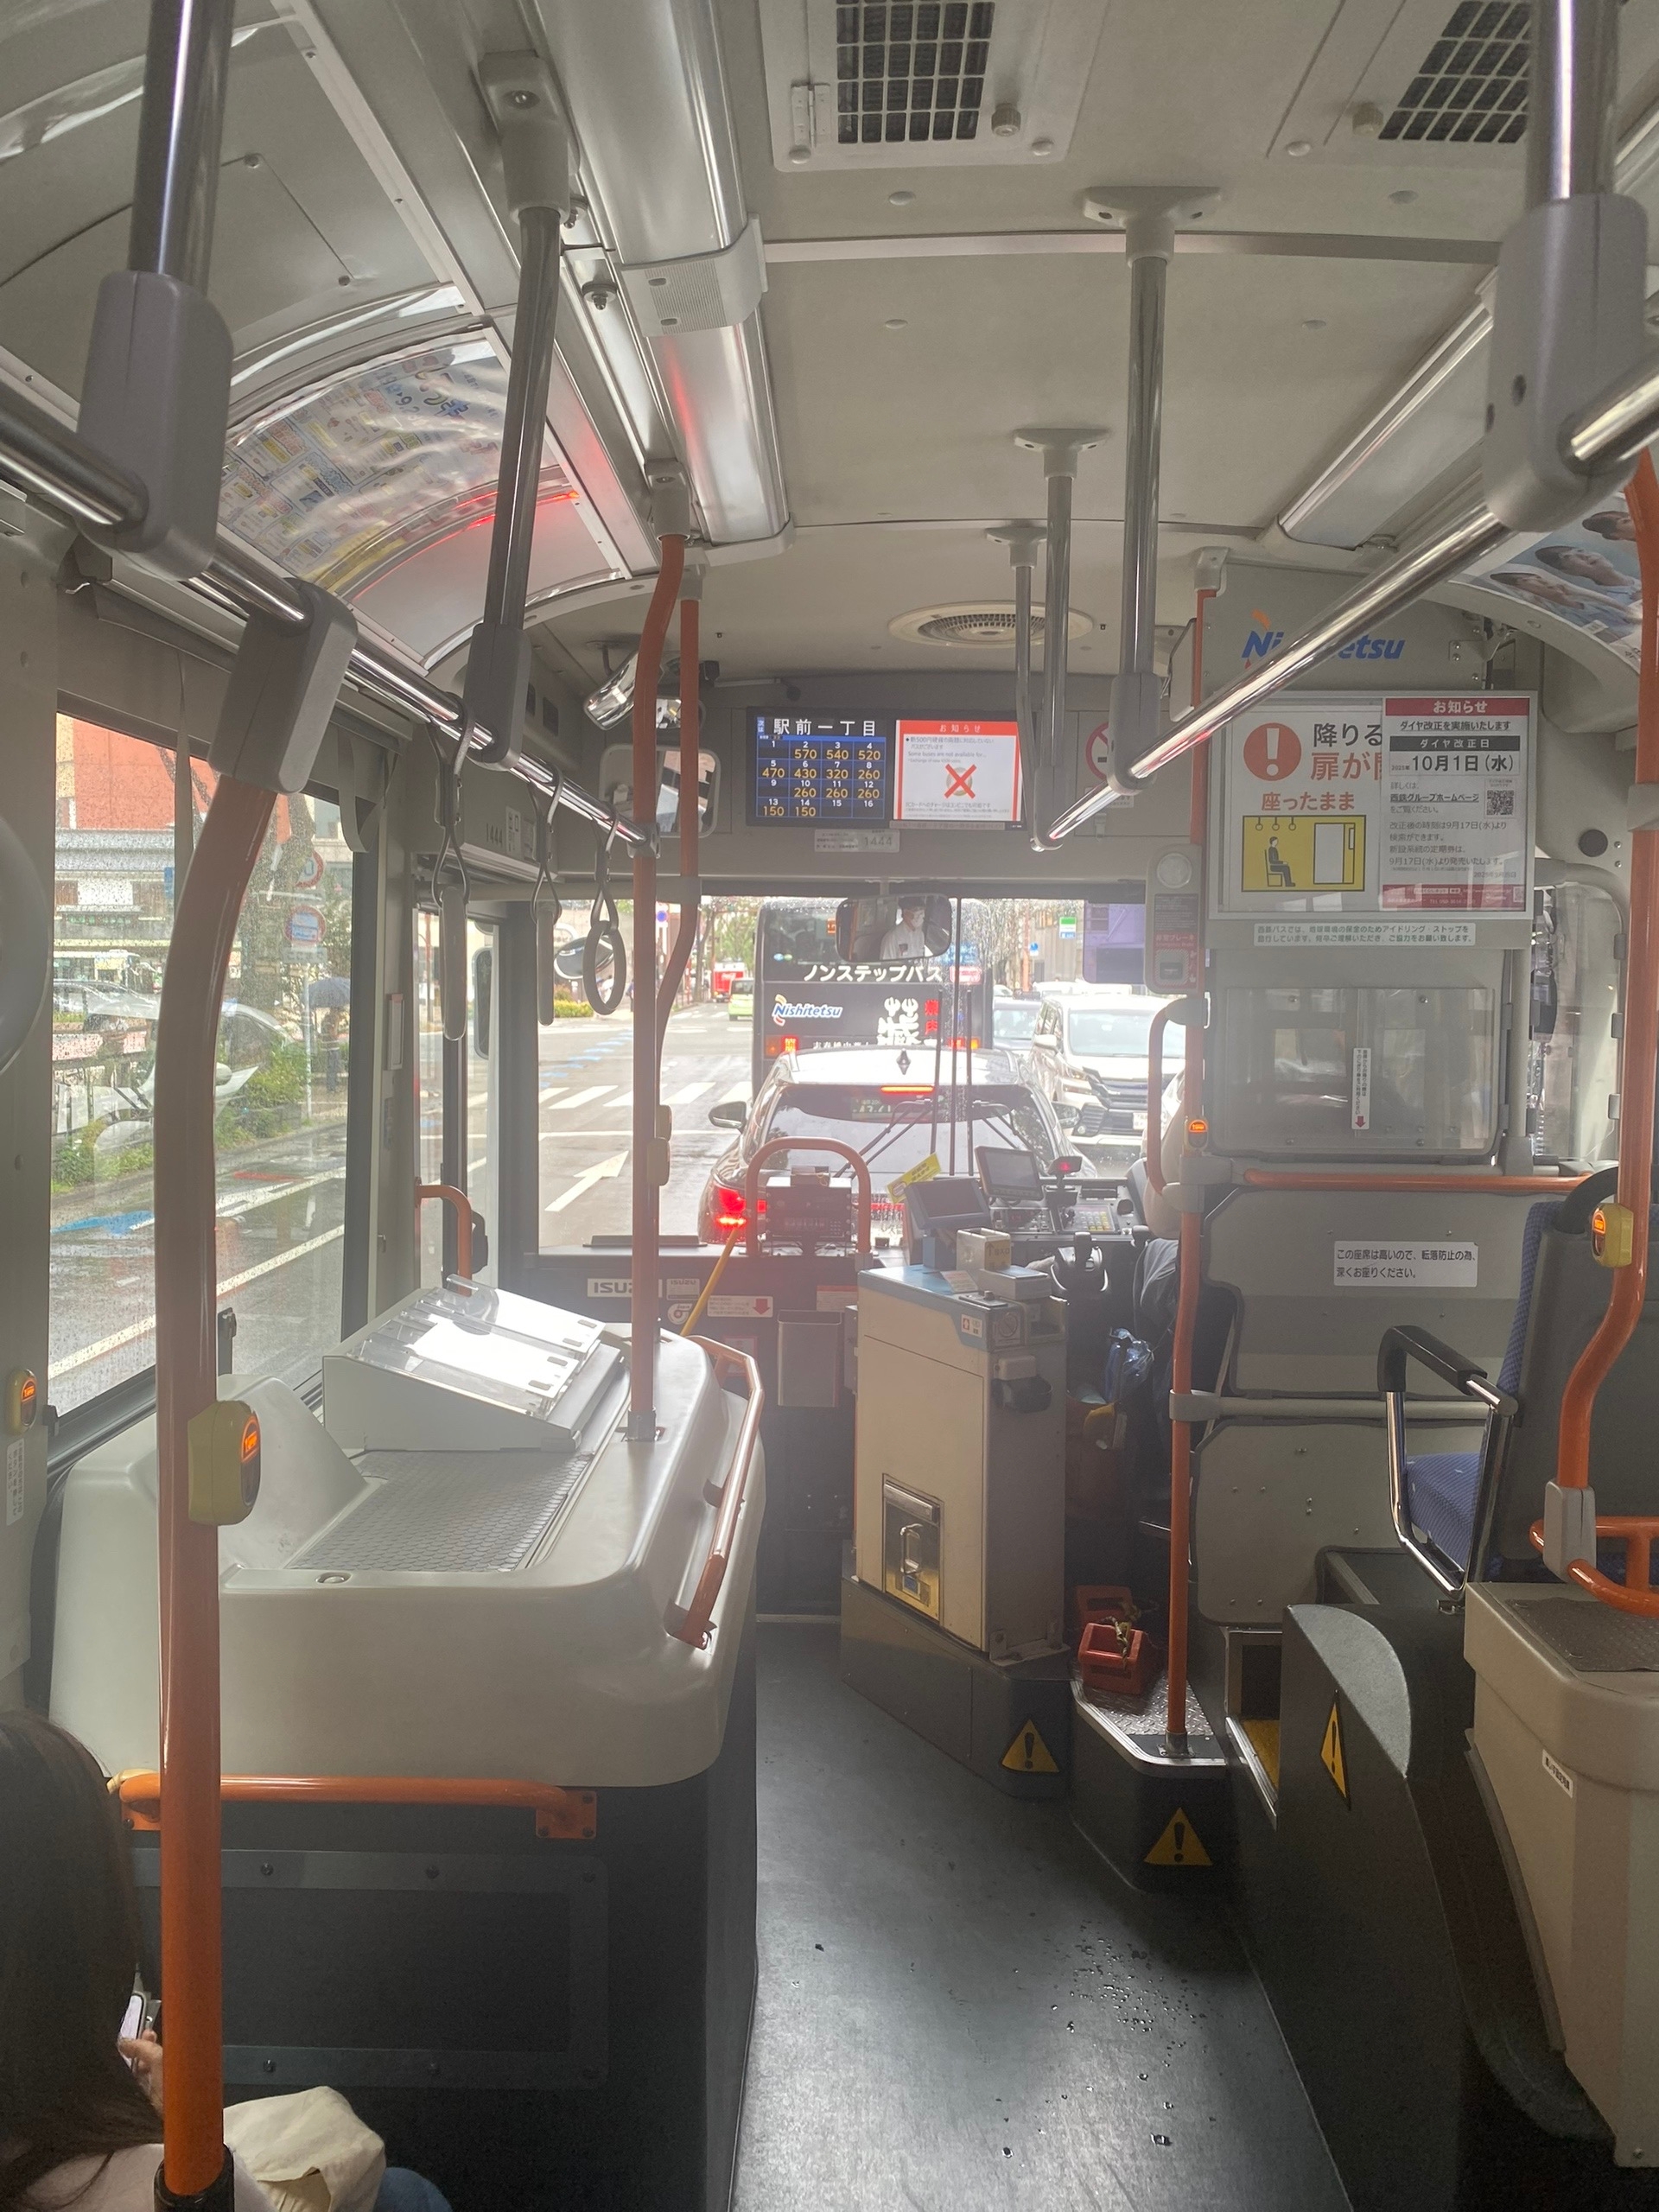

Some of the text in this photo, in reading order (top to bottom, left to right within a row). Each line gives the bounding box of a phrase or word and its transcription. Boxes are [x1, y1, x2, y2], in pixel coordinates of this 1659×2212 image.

[1242, 630, 1406, 659] Nietsu
[1433, 700, 1489, 714] お知らせ
[773, 718, 876, 736] 駅前一丁目
[939, 724, 981, 733] お知らせ
[1400, 721, 1511, 731] ダイヤ改正を実施いたします
[1313, 723, 1382, 747] 降りる
[1420, 739, 1490, 748] ダイヤ改正日
[794, 749, 881, 760] 570 540 520
[762, 767, 880, 779] 470 430 320 260
[794, 787, 880, 798] 260 260 260
[1390, 793, 1479, 803] 西鉄グループホームページ
[1262, 792, 1355, 810] 座ったまま
[763, 805, 817, 817] 150 150
[804, 964, 943, 982] ノンステップバス
[772, 1003, 843, 1018] Nishitetsu
[594, 1282, 632, 1294] ISU
